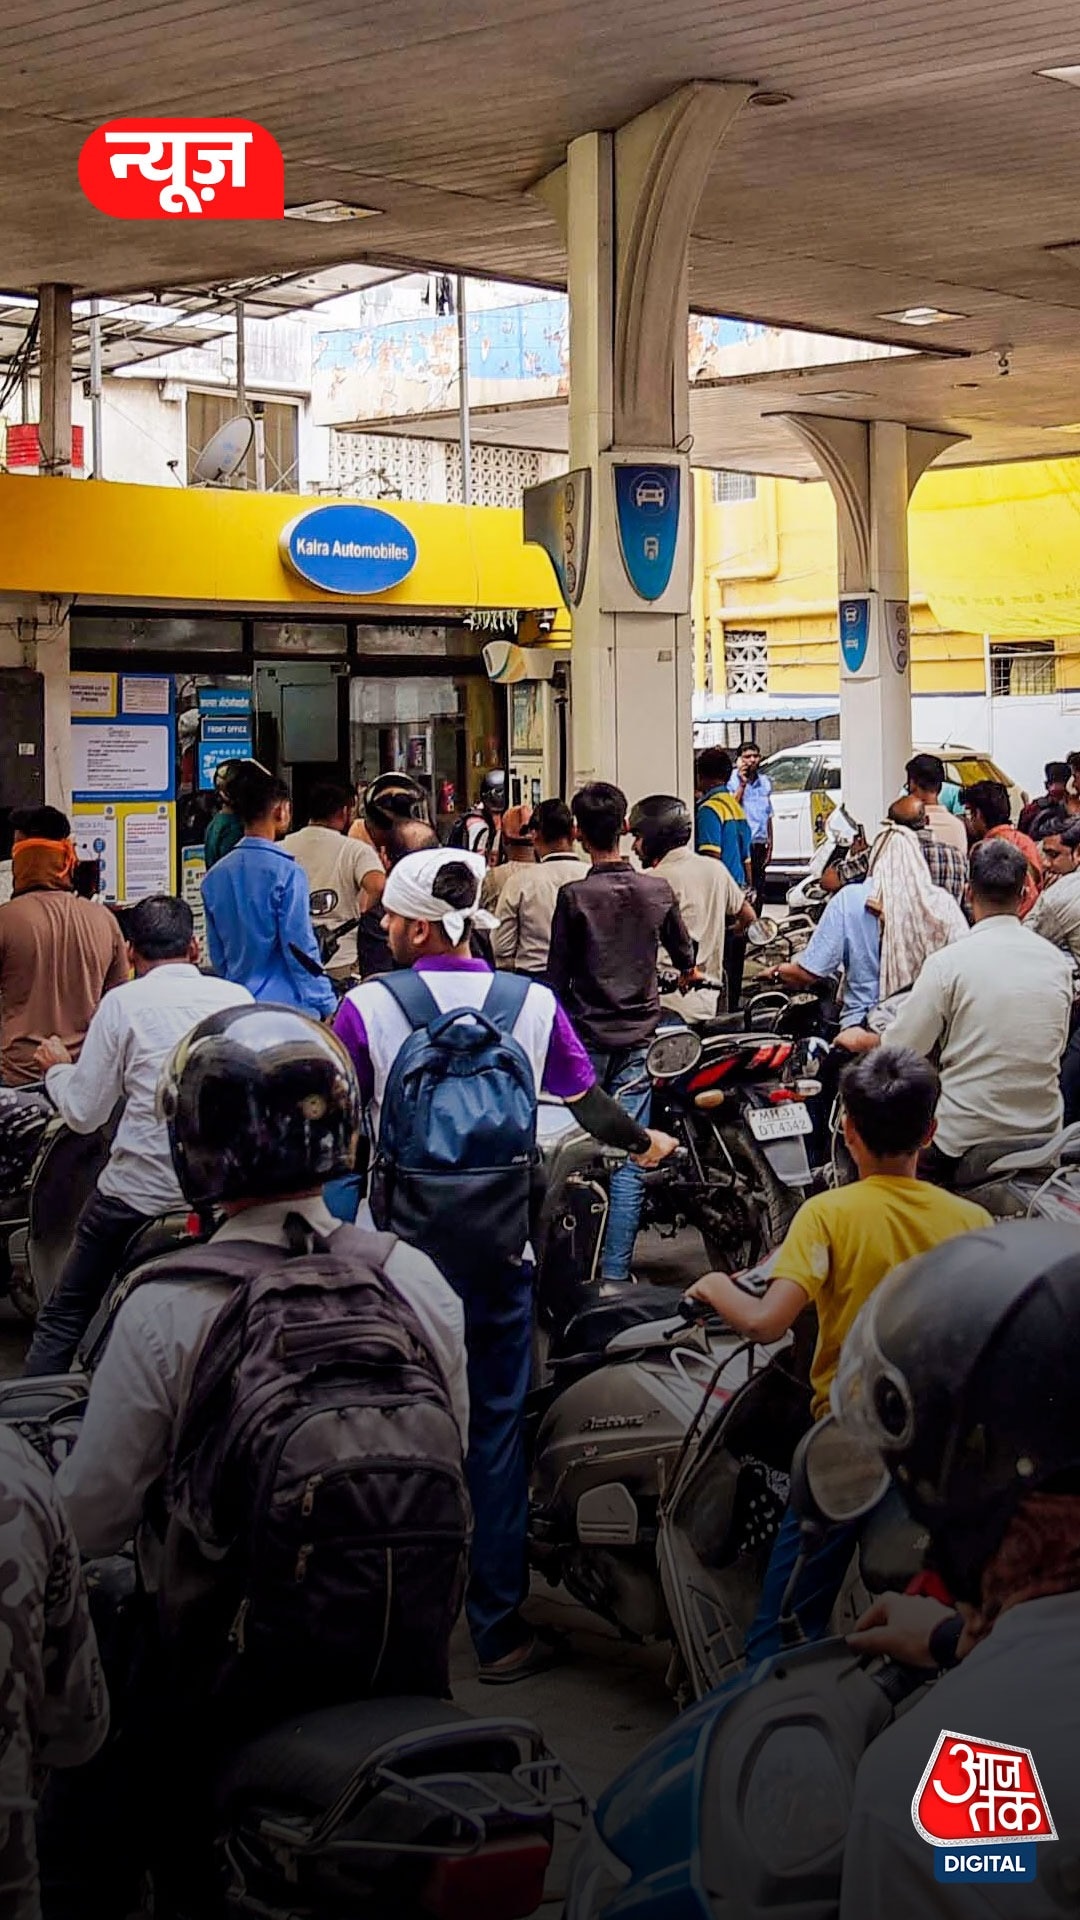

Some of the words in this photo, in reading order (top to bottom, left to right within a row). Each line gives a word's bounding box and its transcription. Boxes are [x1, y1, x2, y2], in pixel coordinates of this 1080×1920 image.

[296, 537, 329, 556] Kalra
[332, 540, 409, 561] Automobiles
[207, 725, 226, 734] FRONT
[227, 725, 247, 734] OFFICE
